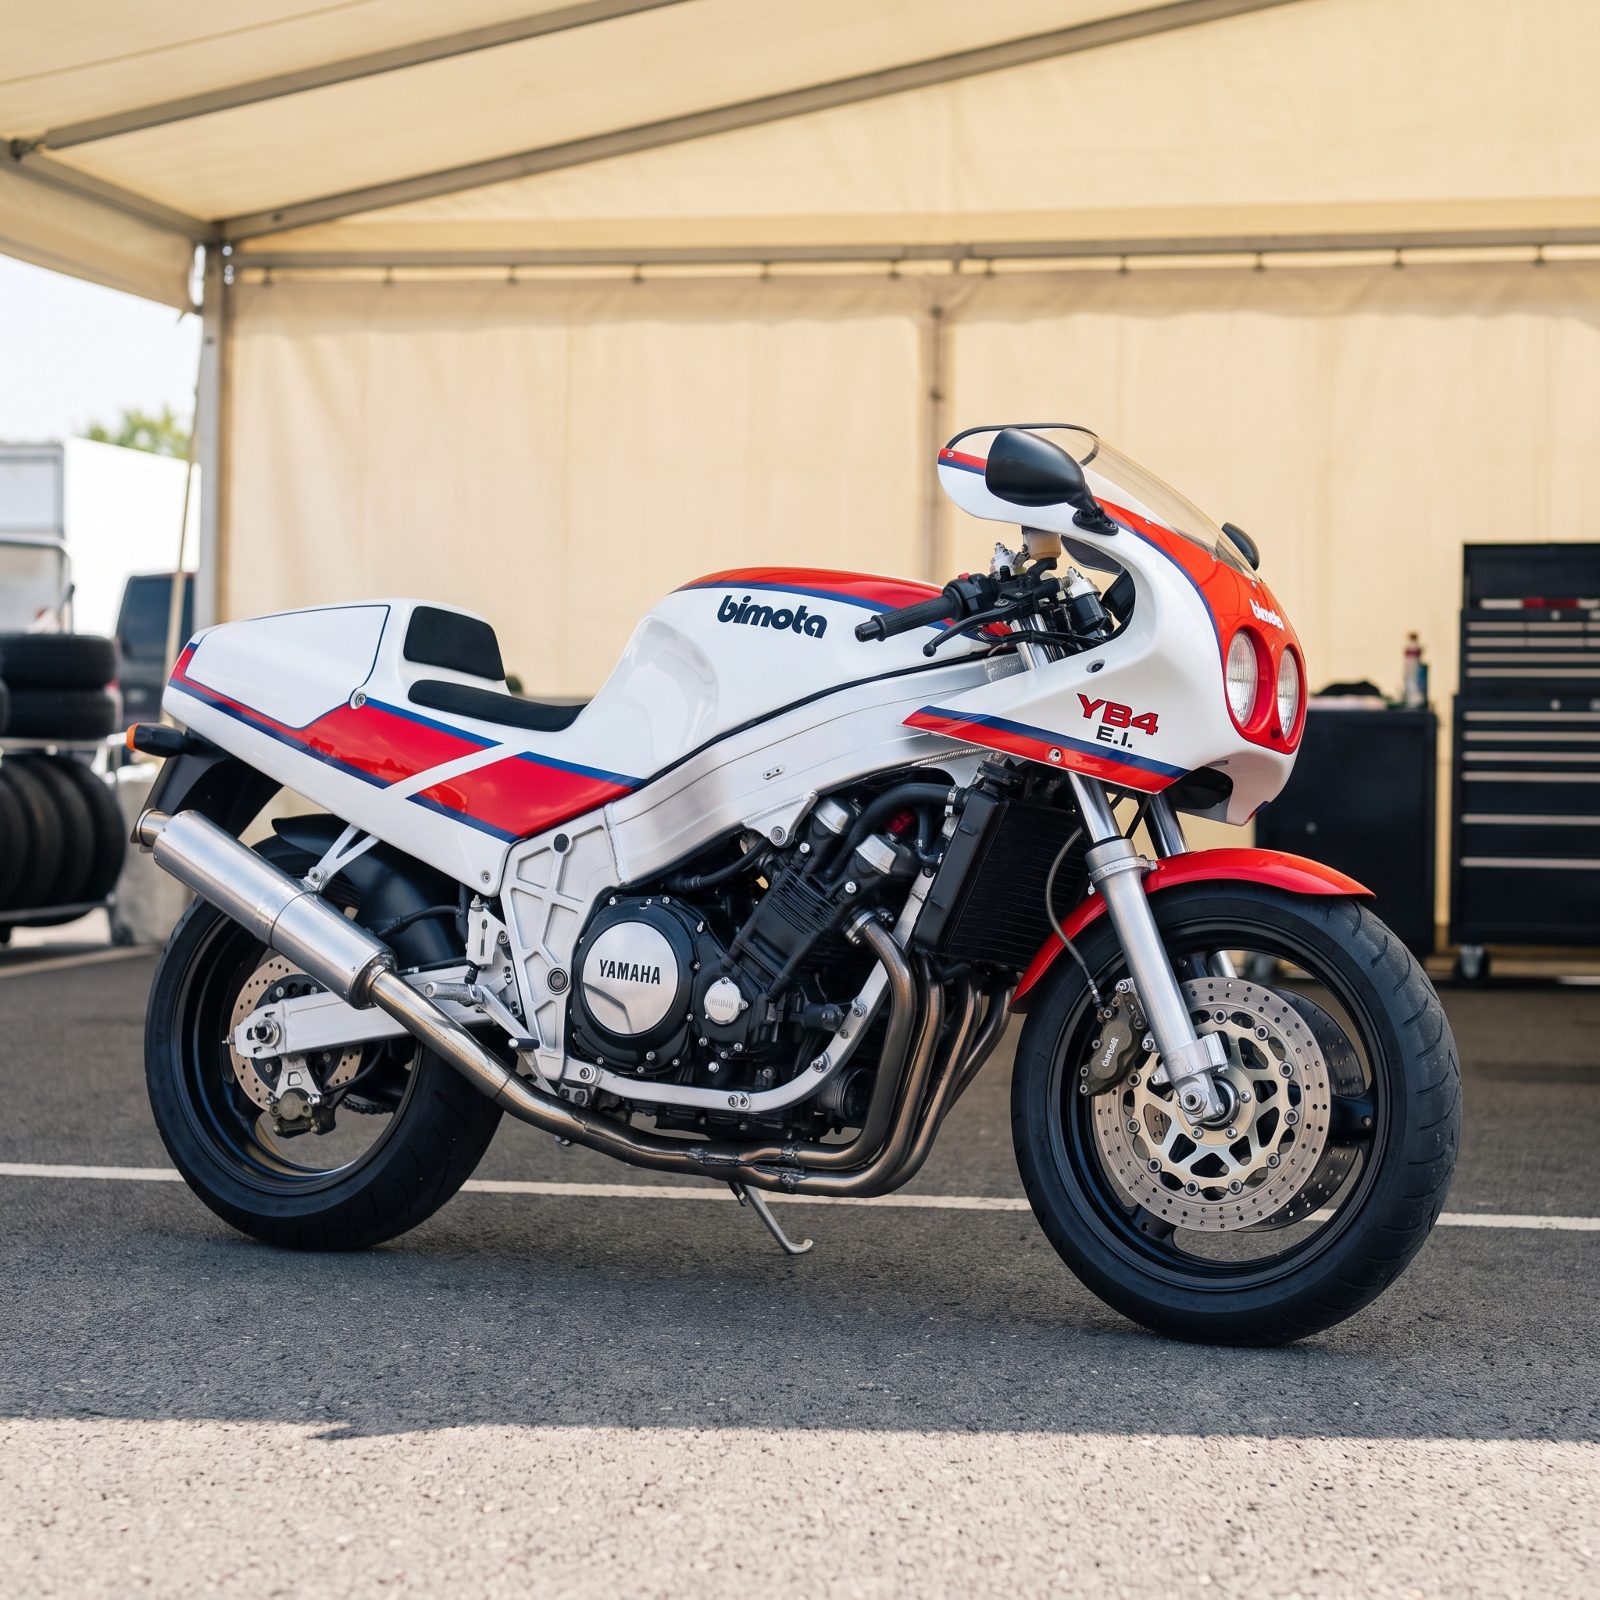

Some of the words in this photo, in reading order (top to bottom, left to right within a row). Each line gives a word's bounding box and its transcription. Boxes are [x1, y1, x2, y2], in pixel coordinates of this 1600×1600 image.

[717, 595, 828, 638] bimota
[1076, 692, 1159, 736] YB4
[1096, 725, 1133, 748] E.I.
[599, 959, 661, 985] YAMAHA
